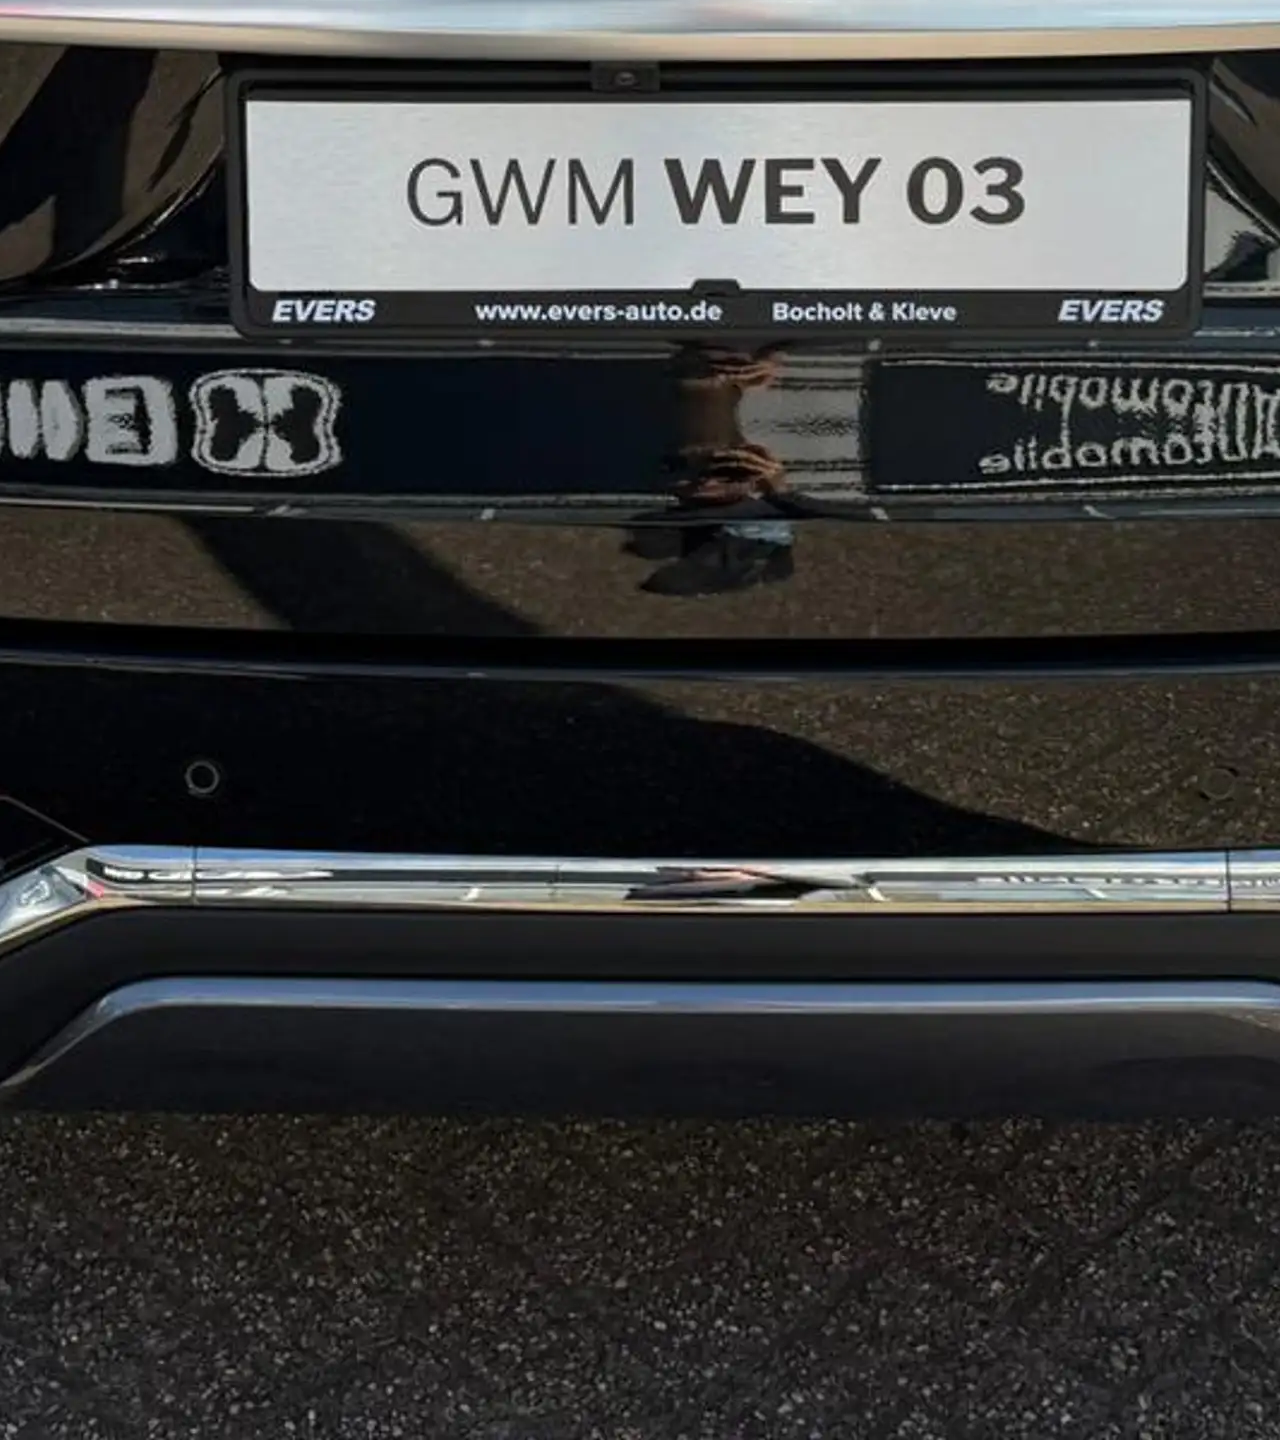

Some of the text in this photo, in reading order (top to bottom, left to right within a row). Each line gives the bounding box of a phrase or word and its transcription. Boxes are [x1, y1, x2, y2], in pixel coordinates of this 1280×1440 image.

[406, 157, 1026, 227] GWM WEY 03
[272, 298, 1165, 323] EVERS www.evers-auto.de Bocholt & Kleve EVERS
